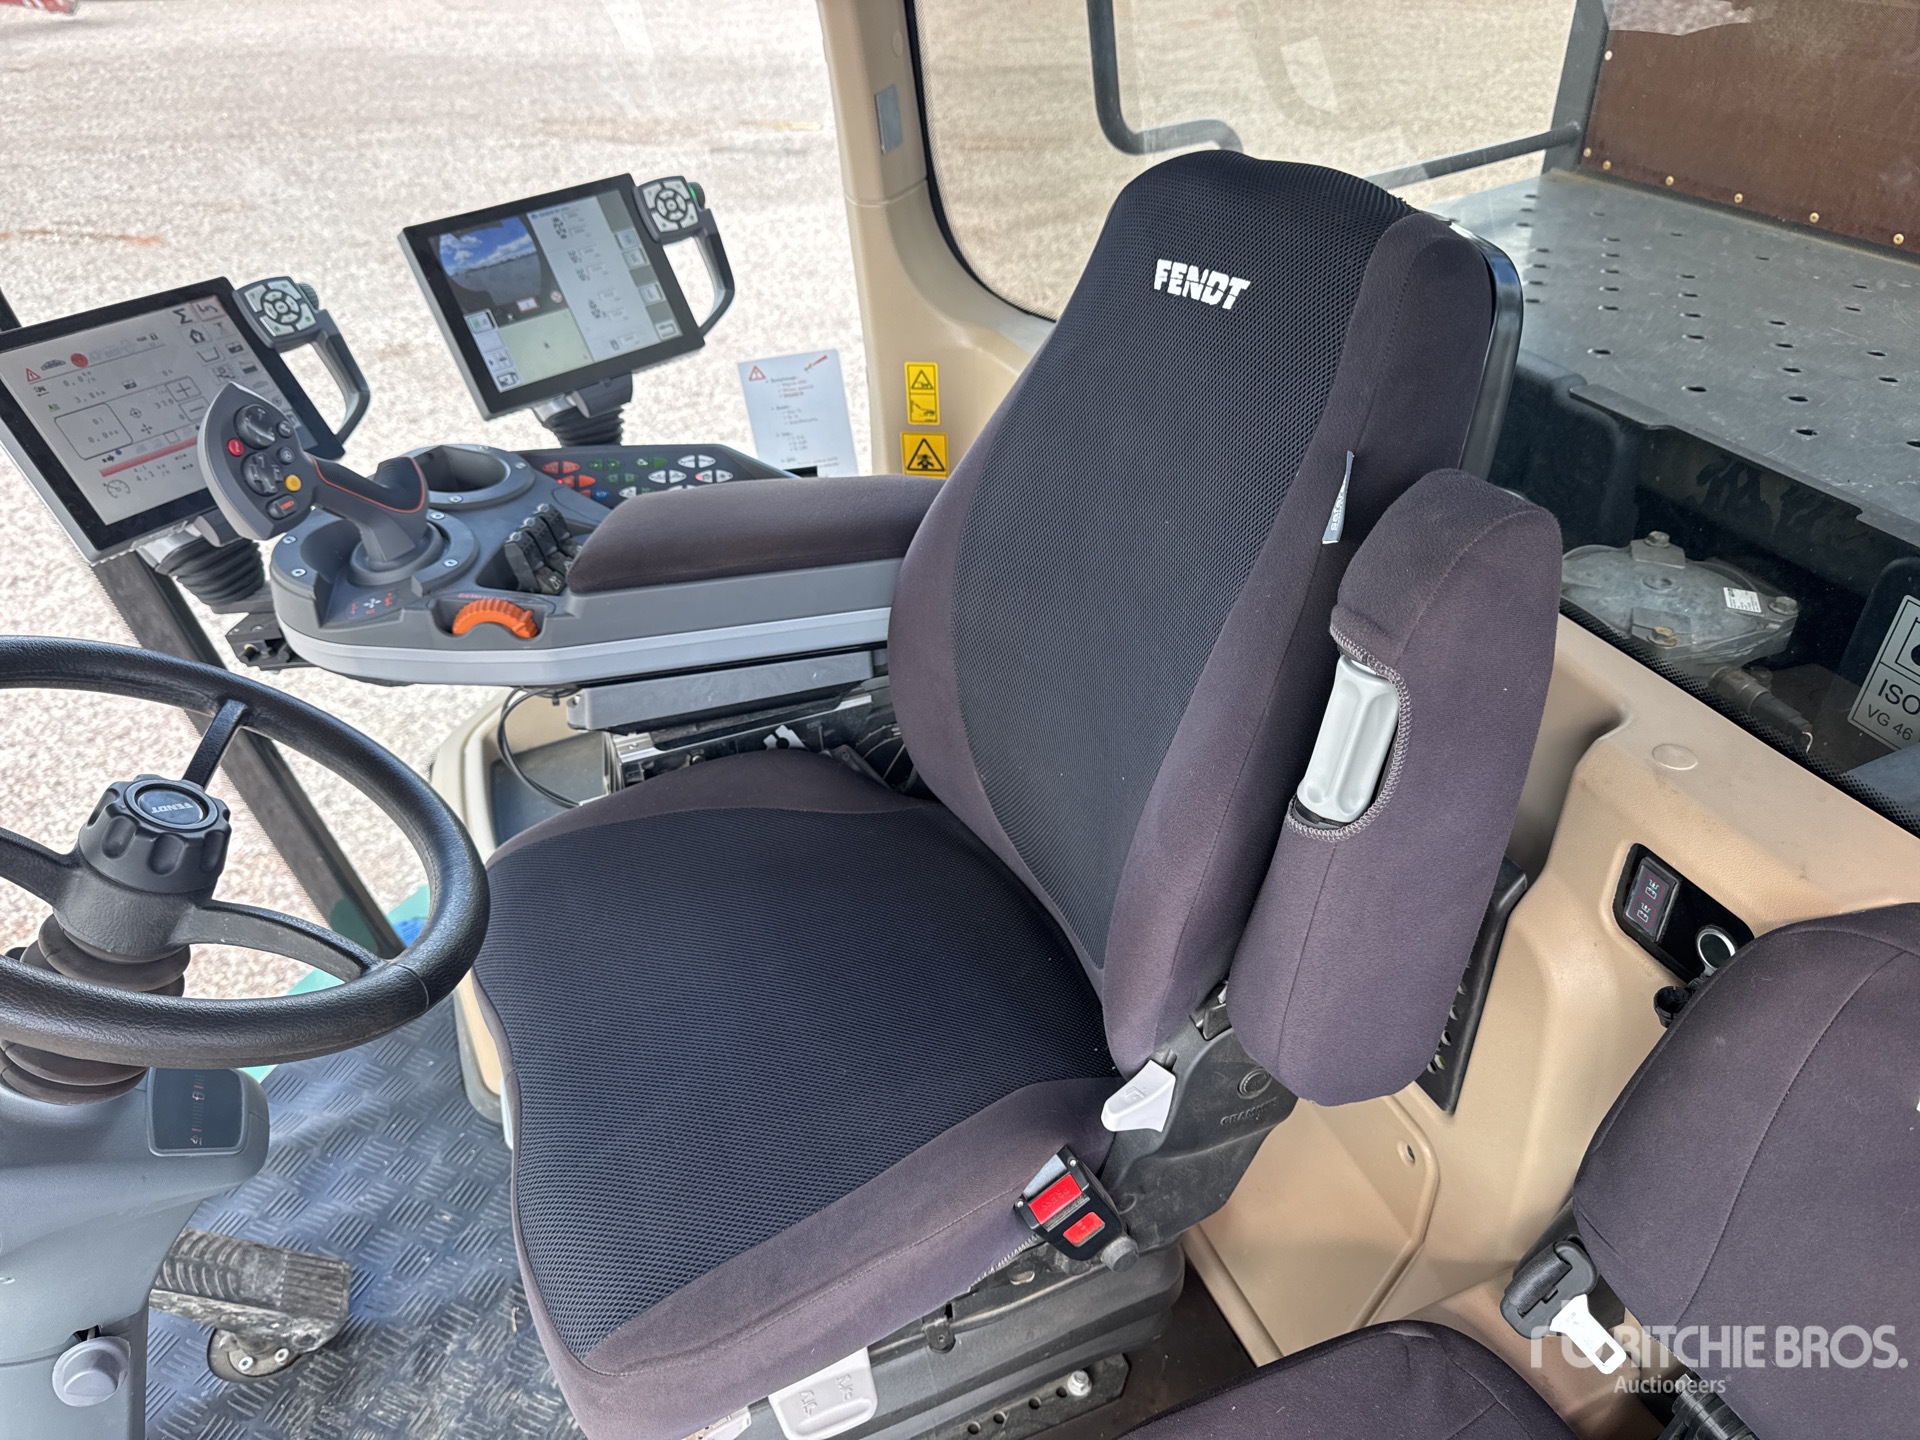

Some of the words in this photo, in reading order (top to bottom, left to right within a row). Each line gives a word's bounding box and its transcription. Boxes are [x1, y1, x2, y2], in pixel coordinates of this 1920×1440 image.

[1153, 258, 1251, 310] FENDT
[1877, 678, 1920, 716] ISO
[1868, 703, 1891, 727] VG
[1892, 722, 1914, 741] 46
[151, 802, 194, 814] FENDT
[1041, 1187, 1071, 1212] PRESS
